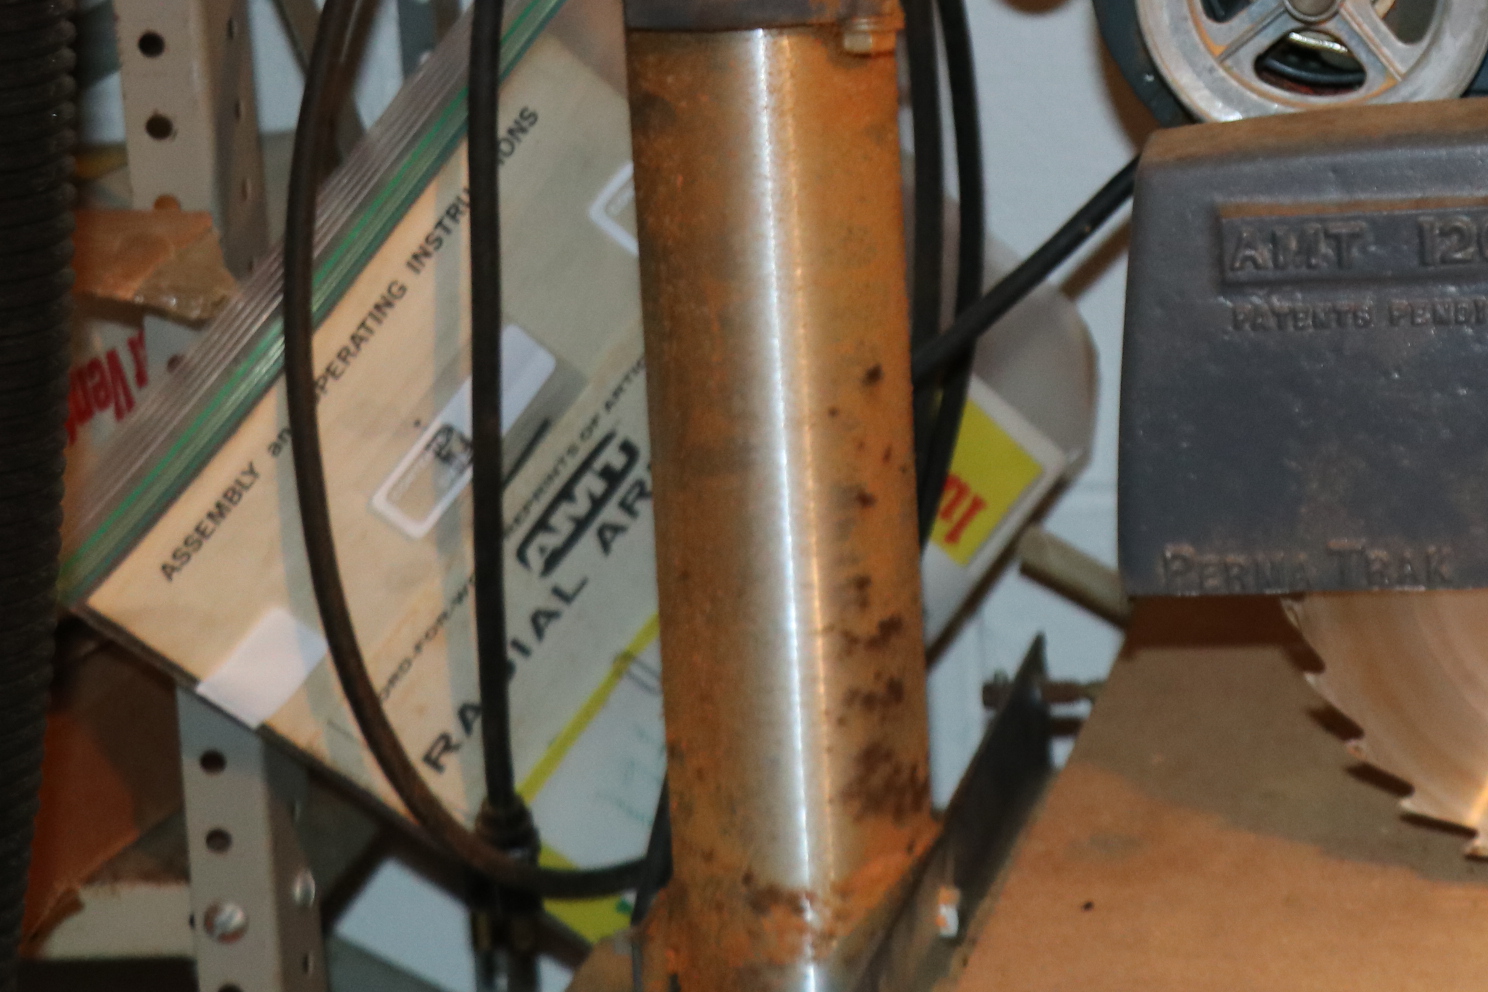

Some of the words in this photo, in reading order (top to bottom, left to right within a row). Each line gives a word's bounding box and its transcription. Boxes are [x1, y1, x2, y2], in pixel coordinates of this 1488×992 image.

[160, 461, 260, 584] ASSEMBLY
[314, 279, 408, 398] PERATING
[422, 576, 588, 775] RAIAL
[597, 463, 653, 556] AR
